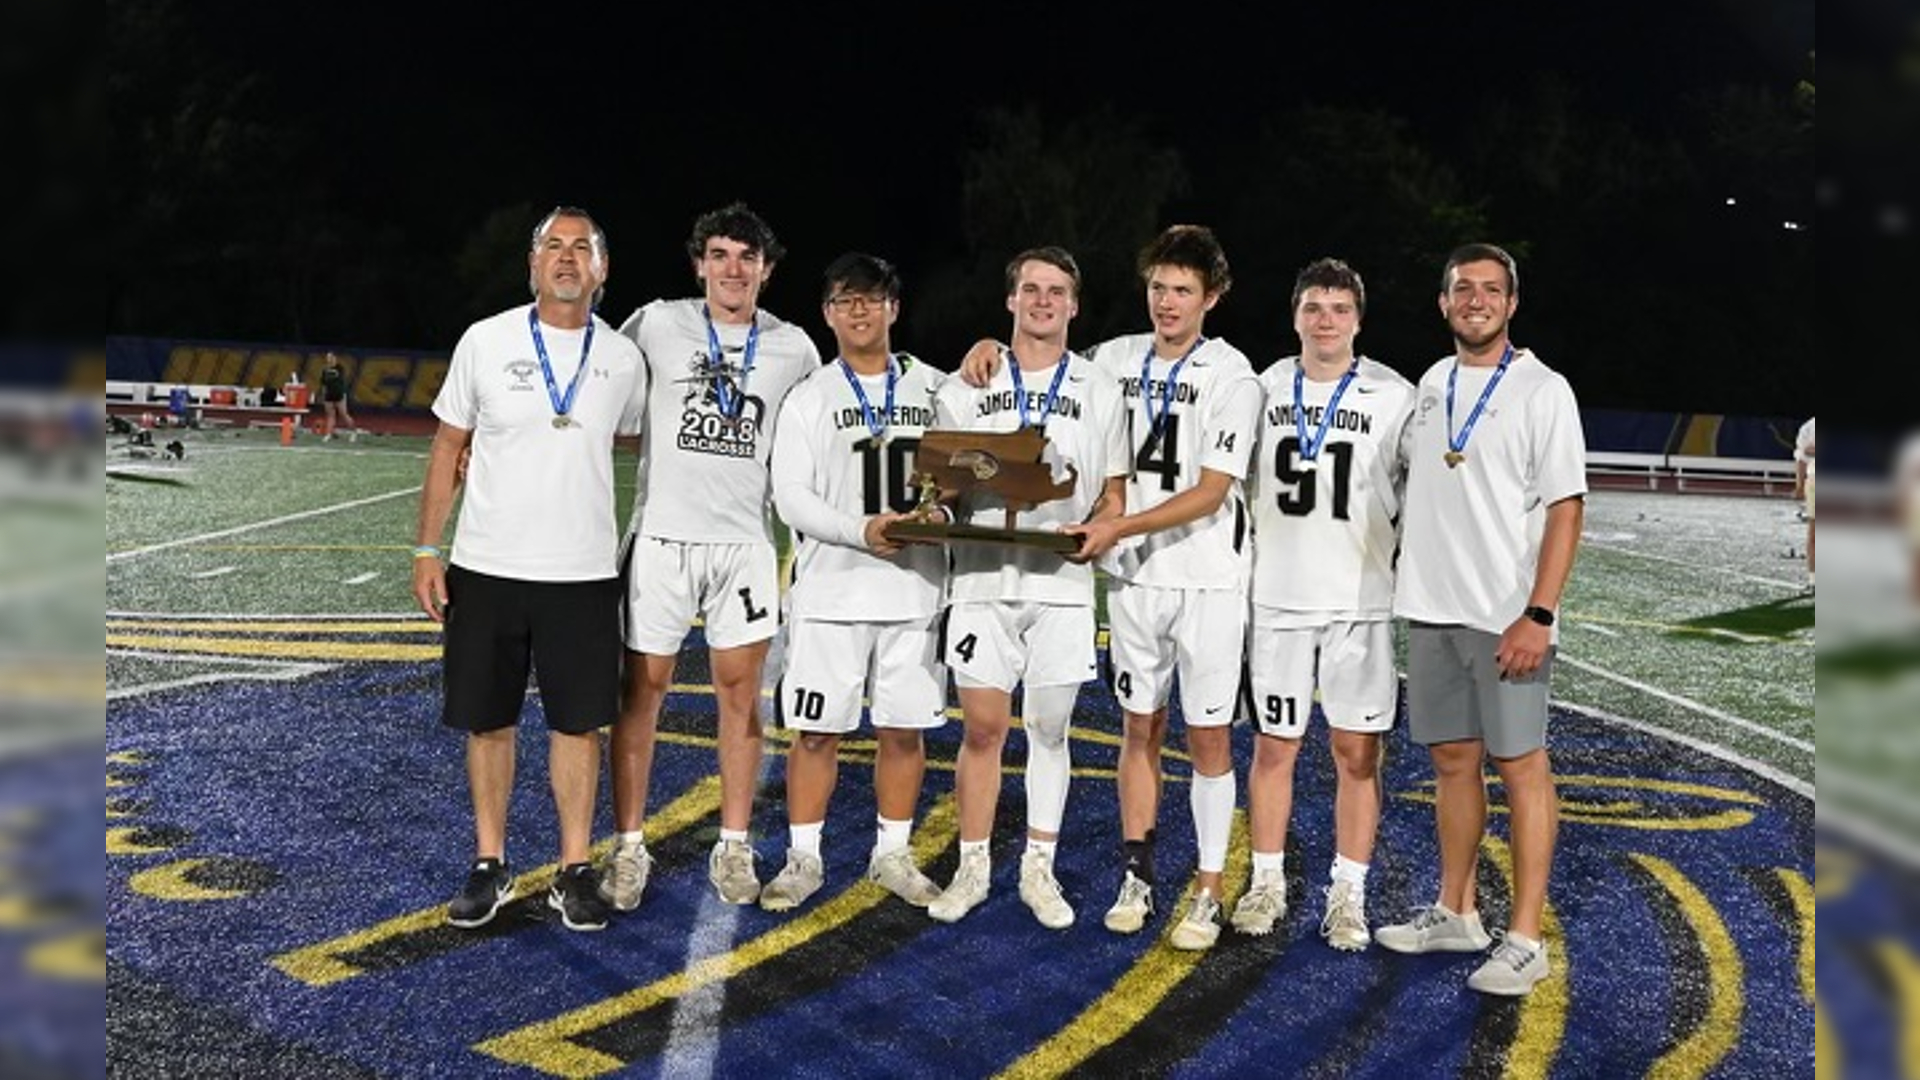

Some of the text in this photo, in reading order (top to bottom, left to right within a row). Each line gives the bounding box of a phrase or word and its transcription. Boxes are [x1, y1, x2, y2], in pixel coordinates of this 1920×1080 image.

[682, 409, 756, 442] 2018
[1215, 430, 1236, 453] 14
[678, 434, 755, 457] LACROSSE
[853, 437, 921, 515] 10
[1275, 436, 1353, 520] 91
[738, 587, 768, 624] L
[955, 633, 977, 663] 4
[794, 687, 825, 721] 10
[1266, 695, 1296, 725] 91
